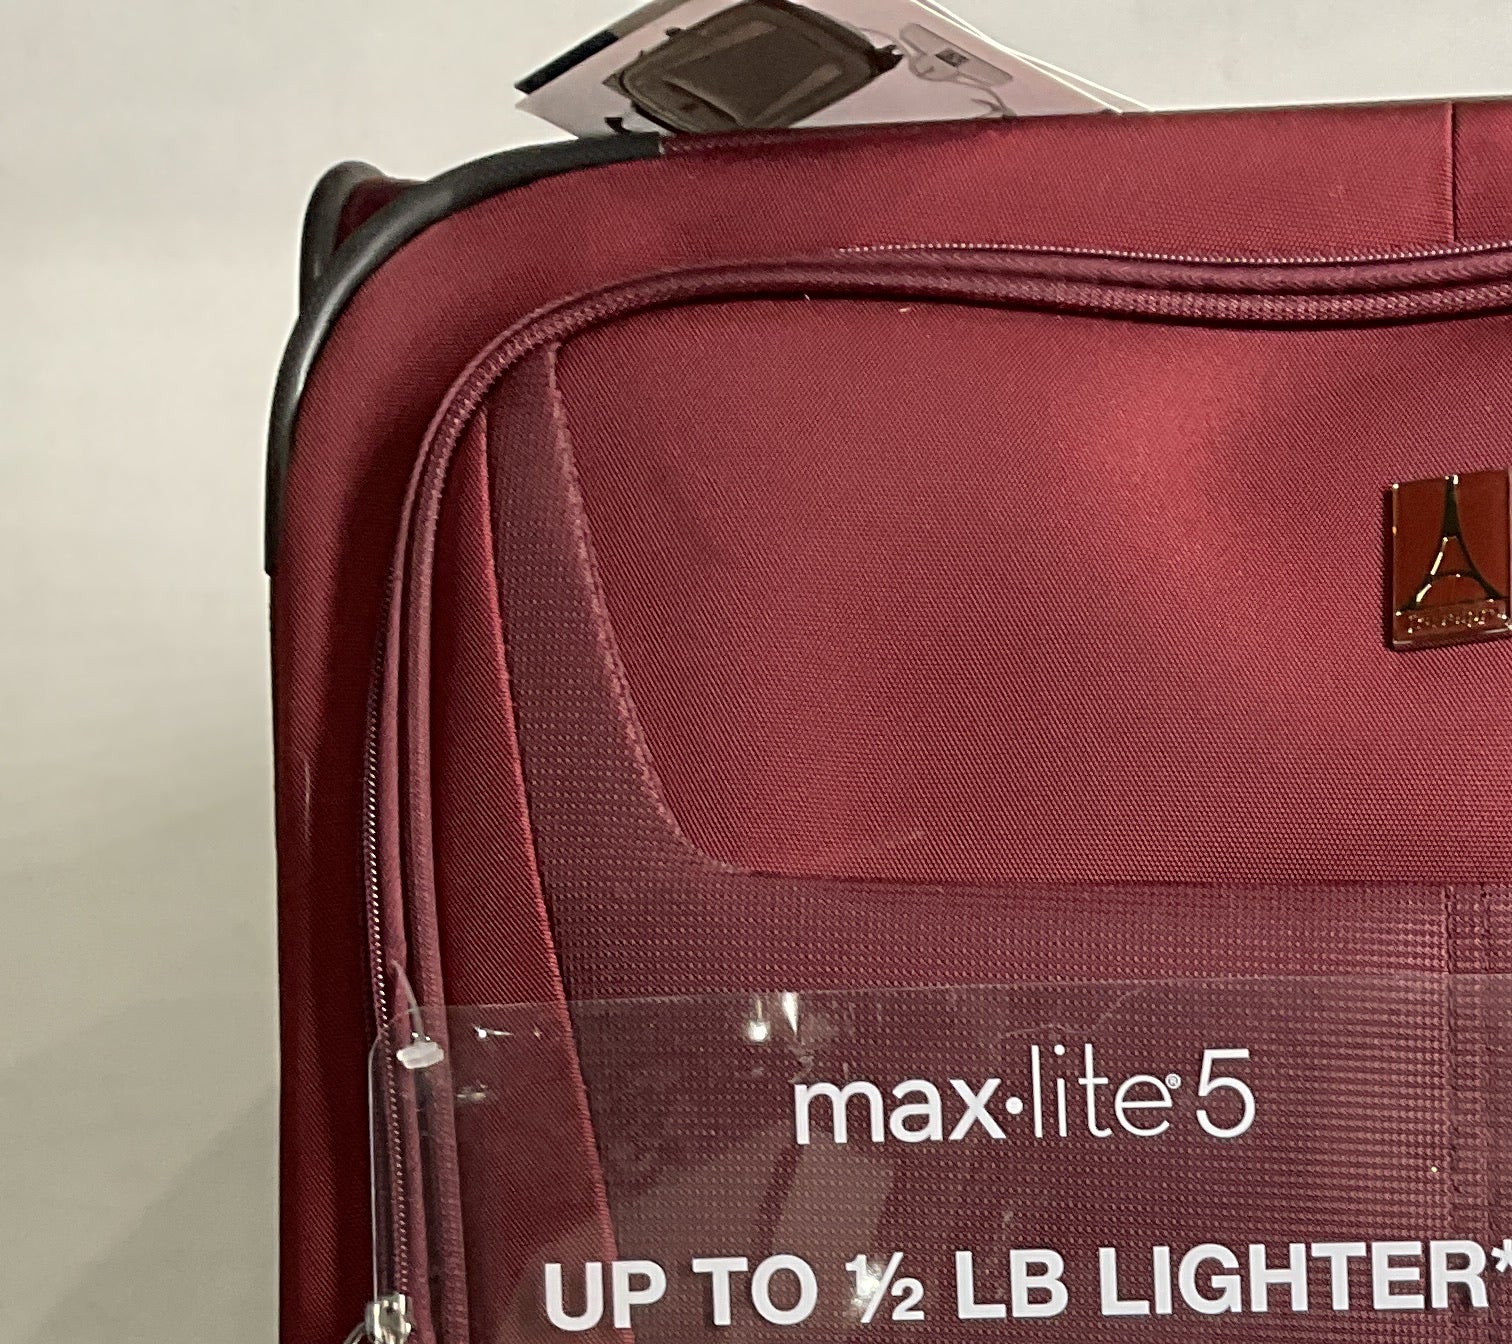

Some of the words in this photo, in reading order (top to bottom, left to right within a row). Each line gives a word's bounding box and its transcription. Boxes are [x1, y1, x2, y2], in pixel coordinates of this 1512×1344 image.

[1196, 1048, 1256, 1139] 5
[543, 1260, 667, 1331] UP
[694, 1253, 819, 1326] TO
[957, 1247, 1071, 1319] LB
